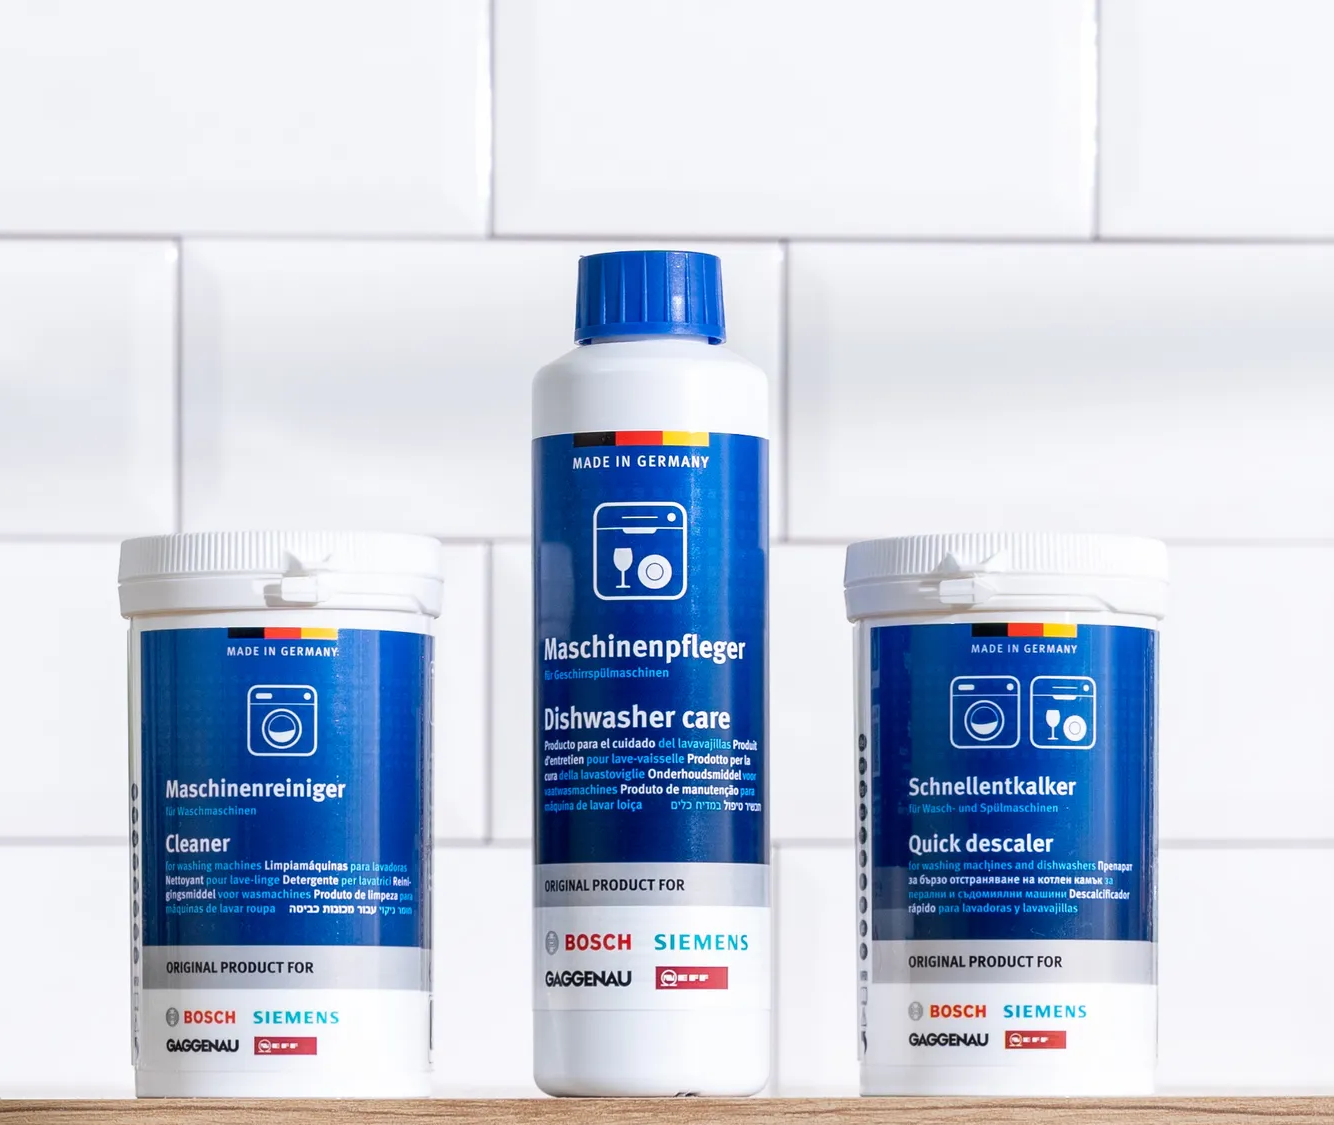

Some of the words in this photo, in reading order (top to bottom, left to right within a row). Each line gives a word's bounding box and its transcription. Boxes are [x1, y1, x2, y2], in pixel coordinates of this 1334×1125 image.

[573, 456, 610, 469] MADE
[616, 456, 630, 467] IN
[637, 456, 709, 468] GERMANY
[227, 647, 259, 656] MADE
[264, 647, 276, 656] IN
[281, 647, 338, 657] GERMANY
[544, 634, 746, 664] Maschinenpfleger
[971, 644, 1003, 653] MADE
[1007, 644, 1019, 653] IN
[1024, 644, 1077, 654] GERMANY
[554, 667, 669, 681] Geschirrspülmaschinen
[544, 704, 675, 731] Dishwasher
[682, 710, 731, 729] care
[544, 740, 575, 750] Producto
[577, 741, 598, 752] para
[601, 738, 610, 748] el
[612, 738, 655, 748] cuidado
[659, 738, 675, 748] del
[678, 738, 731, 750] lavavajillas
[733, 740, 757, 750] Produit
[545, 754, 584, 766] d'entretien
[587, 756, 609, 766] pour
[612, 754, 685, 764] lave-vaisselle
[687, 754, 728, 764] Prodotto
[730, 757, 743, 767] per
[744, 755, 750, 765] la
[545, 772, 557, 781] cura
[559, 770, 578, 780] della
[581, 769, 645, 781] lavastoviglie
[648, 768, 741, 780] Onderhoudsmiddel
[166, 778, 346, 802] Maschinenreiniger
[621, 784, 663, 794] Produto
[666, 784, 679, 794] de
[682, 785, 739, 797] manutenção
[740, 787, 755, 797] para
[909, 776, 1077, 796] Schnellentkalker
[177, 806, 257, 816] Waschmaschinen
[577, 800, 587, 810] de
[590, 800, 614, 810] lavar
[617, 799, 642, 812] loiça
[909, 804, 921, 814] für
[922, 804, 955, 814] Wasch-
[959, 803, 977, 813] und
[980, 802, 1058, 815] Spülmaschinen
[165, 835, 230, 852] Cleaner
[909, 834, 961, 854] Quick
[966, 834, 1053, 852] descaler
[166, 860, 175, 870] for
[177, 861, 212, 872] washing
[215, 860, 261, 870] machines
[265, 860, 348, 872] Limpiamáquinas
[351, 864, 370, 872] para
[372, 862, 407, 872] lavadoras
[909, 861, 919, 870] for
[922, 860, 961, 872] washing
[963, 860, 1012, 870] machines
[1015, 860, 1034, 870] and
[1037, 860, 1096, 871] dishwashers
[1098, 861, 1133, 873] Препарат
[166, 876, 204, 887] Nettoyant
[206, 876, 227, 887] pour
[230, 875, 280, 886] lave-linge
[283, 875, 339, 886] Detergente
[342, 877, 356, 887] per
[359, 876, 391, 886] lavatrici
[393, 876, 411, 886] Reini-
[545, 879, 590, 892] ORIGINAL
[593, 879, 655, 891] PRODUCT
[659, 879, 685, 891] FOR
[908, 876, 917, 884] за
[920, 874, 947, 886] бързо
[950, 876, 1020, 886] отстраняване
[1023, 876, 1035, 884] на
[1038, 876, 1071, 884] котлен
[166, 889, 216, 902] gingsmiddel
[218, 891, 239, 899] voor
[242, 889, 311, 899] wasmachines
[314, 889, 352, 900] Produto
[355, 890, 365, 900] de
[368, 890, 398, 902] limpeza
[909, 890, 946, 900] перални
[958, 890, 1022, 899] съдомиялни
[1025, 890, 1067, 898] машини
[1069, 889, 1130, 900] Descalcificador
[166, 904, 203, 915] máquinas
[206, 904, 217, 913] de
[220, 904, 243, 913] lavar
[246, 905, 275, 915] roupa
[908, 903, 936, 915] rápido
[939, 905, 959, 915] para
[963, 903, 1011, 913] lavadoras
[1014, 906, 1020, 915] y
[1023, 903, 1078, 914] lavavajillas
[565, 934, 631, 950] BOSCH
[654, 934, 748, 951] SIEMENS
[166, 962, 217, 974] ORIGINAL
[221, 962, 284, 974] PRODUCT
[288, 962, 314, 974] FOR
[909, 956, 965, 968] ORIGINAL
[969, 956, 1034, 968] PRODUCT
[1037, 956, 1062, 968] FOR
[545, 970, 632, 987] GAGGENAU
[184, 1011, 236, 1024] BOSCH
[253, 1011, 339, 1024] SIEMENS
[930, 1005, 986, 1018] BOSCH
[1003, 1005, 1086, 1018] SIEMENS
[166, 1039, 239, 1052] GAGGENAU
[909, 1033, 989, 1046] GAGGENAU
